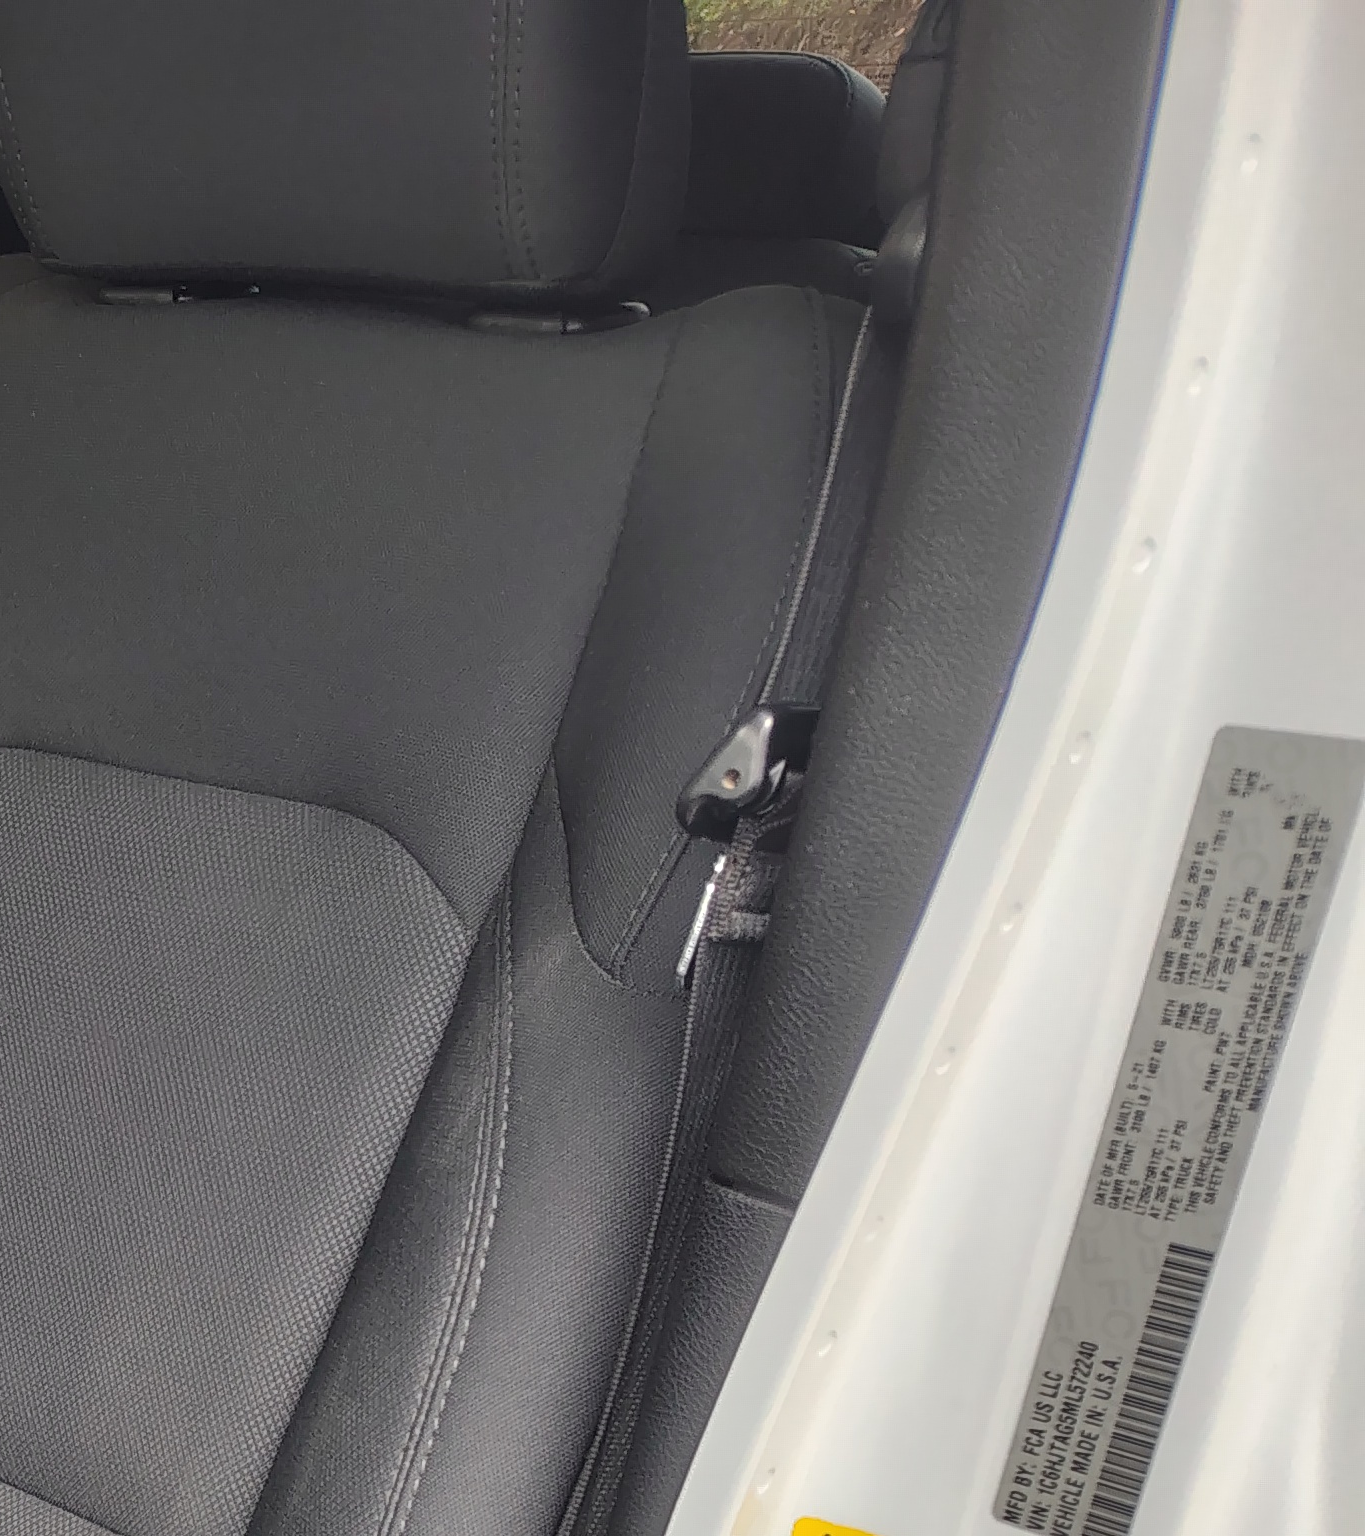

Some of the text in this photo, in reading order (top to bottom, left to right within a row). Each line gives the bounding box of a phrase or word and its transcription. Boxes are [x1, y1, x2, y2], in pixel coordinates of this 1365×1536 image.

[1294, 803, 1321, 851] VEHICL
[1316, 815, 1334, 834] OF
[1299, 866, 1318, 891] THE
[1293, 891, 1311, 910] ON
[1275, 954, 1289, 967] IN
[1159, 998, 1178, 1027] WITH
[1173, 1001, 1191, 1030] RIMS
[1187, 999, 1208, 1033] TIRES
[1234, 980, 1265, 1047] APPLICABLE
[1254, 968, 1285, 1036] STANDARDS
[1201, 1006, 1222, 1036] COLD
[1226, 1048, 1245, 1069] ALL
[1233, 1035, 1264, 1103] PREVENTION
[1221, 1069, 1238, 1086] TO
[1203, 1086, 1233, 1146] CONFORMS
[1222, 1105, 1244, 1139] THEFT
[1106, 1138, 1123, 1161] MFR
[1214, 1139, 1233, 1164] AND
[1101, 1163, 1115, 1178] OF
[1147, 1204, 1162, 1219] AT
[1172, 1118, 1188, 1137] PSI
[1172, 1155, 1194, 1191] TRUCK
[1190, 1144, 1215, 1189] VEHICLE
[1093, 1179, 1111, 1206] DATE
[1107, 1178, 1126, 1210] GAWR
[1202, 1164, 1226, 1205] SAFETY
[1182, 1189, 1202, 1215] THIS
[1091, 1351, 1123, 1402] U.S.A.
[1083, 1402, 1107, 1427] IN:
[1002, 1369, 1064, 1525] MFD BY: FCA US LLC
[1025, 1339, 1100, 1532] VIN: 1C6HJTAG5ML572240
[1068, 1428, 1099, 1476] MADE
